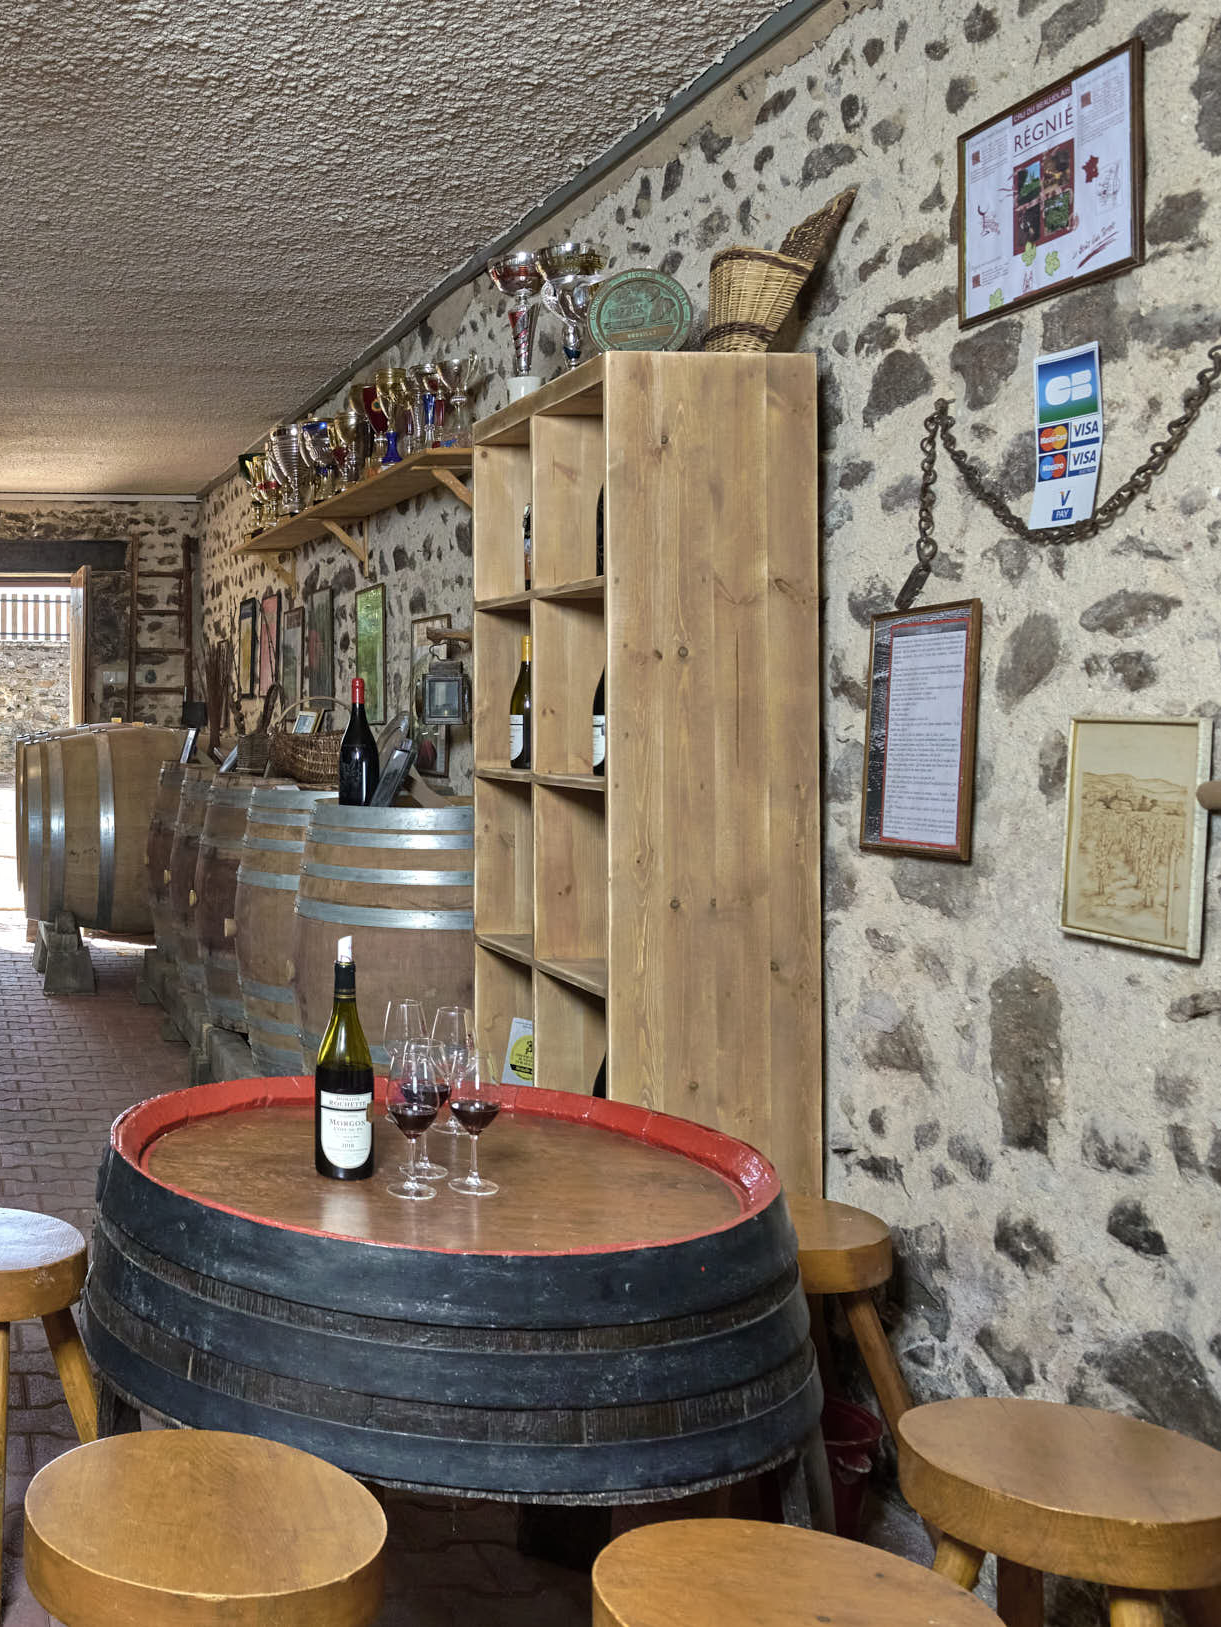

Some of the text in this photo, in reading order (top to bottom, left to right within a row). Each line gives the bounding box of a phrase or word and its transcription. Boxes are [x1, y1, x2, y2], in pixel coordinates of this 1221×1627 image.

[1013, 103, 1073, 152] RÉGNIÉ
[1044, 369, 1093, 406] CB
[1073, 420, 1099, 438] VISA
[1072, 449, 1097, 467] VISA
[1059, 489, 1071, 507] V
[1055, 509, 1070, 519] PAY
[329, 1118, 366, 1127] MORGON
